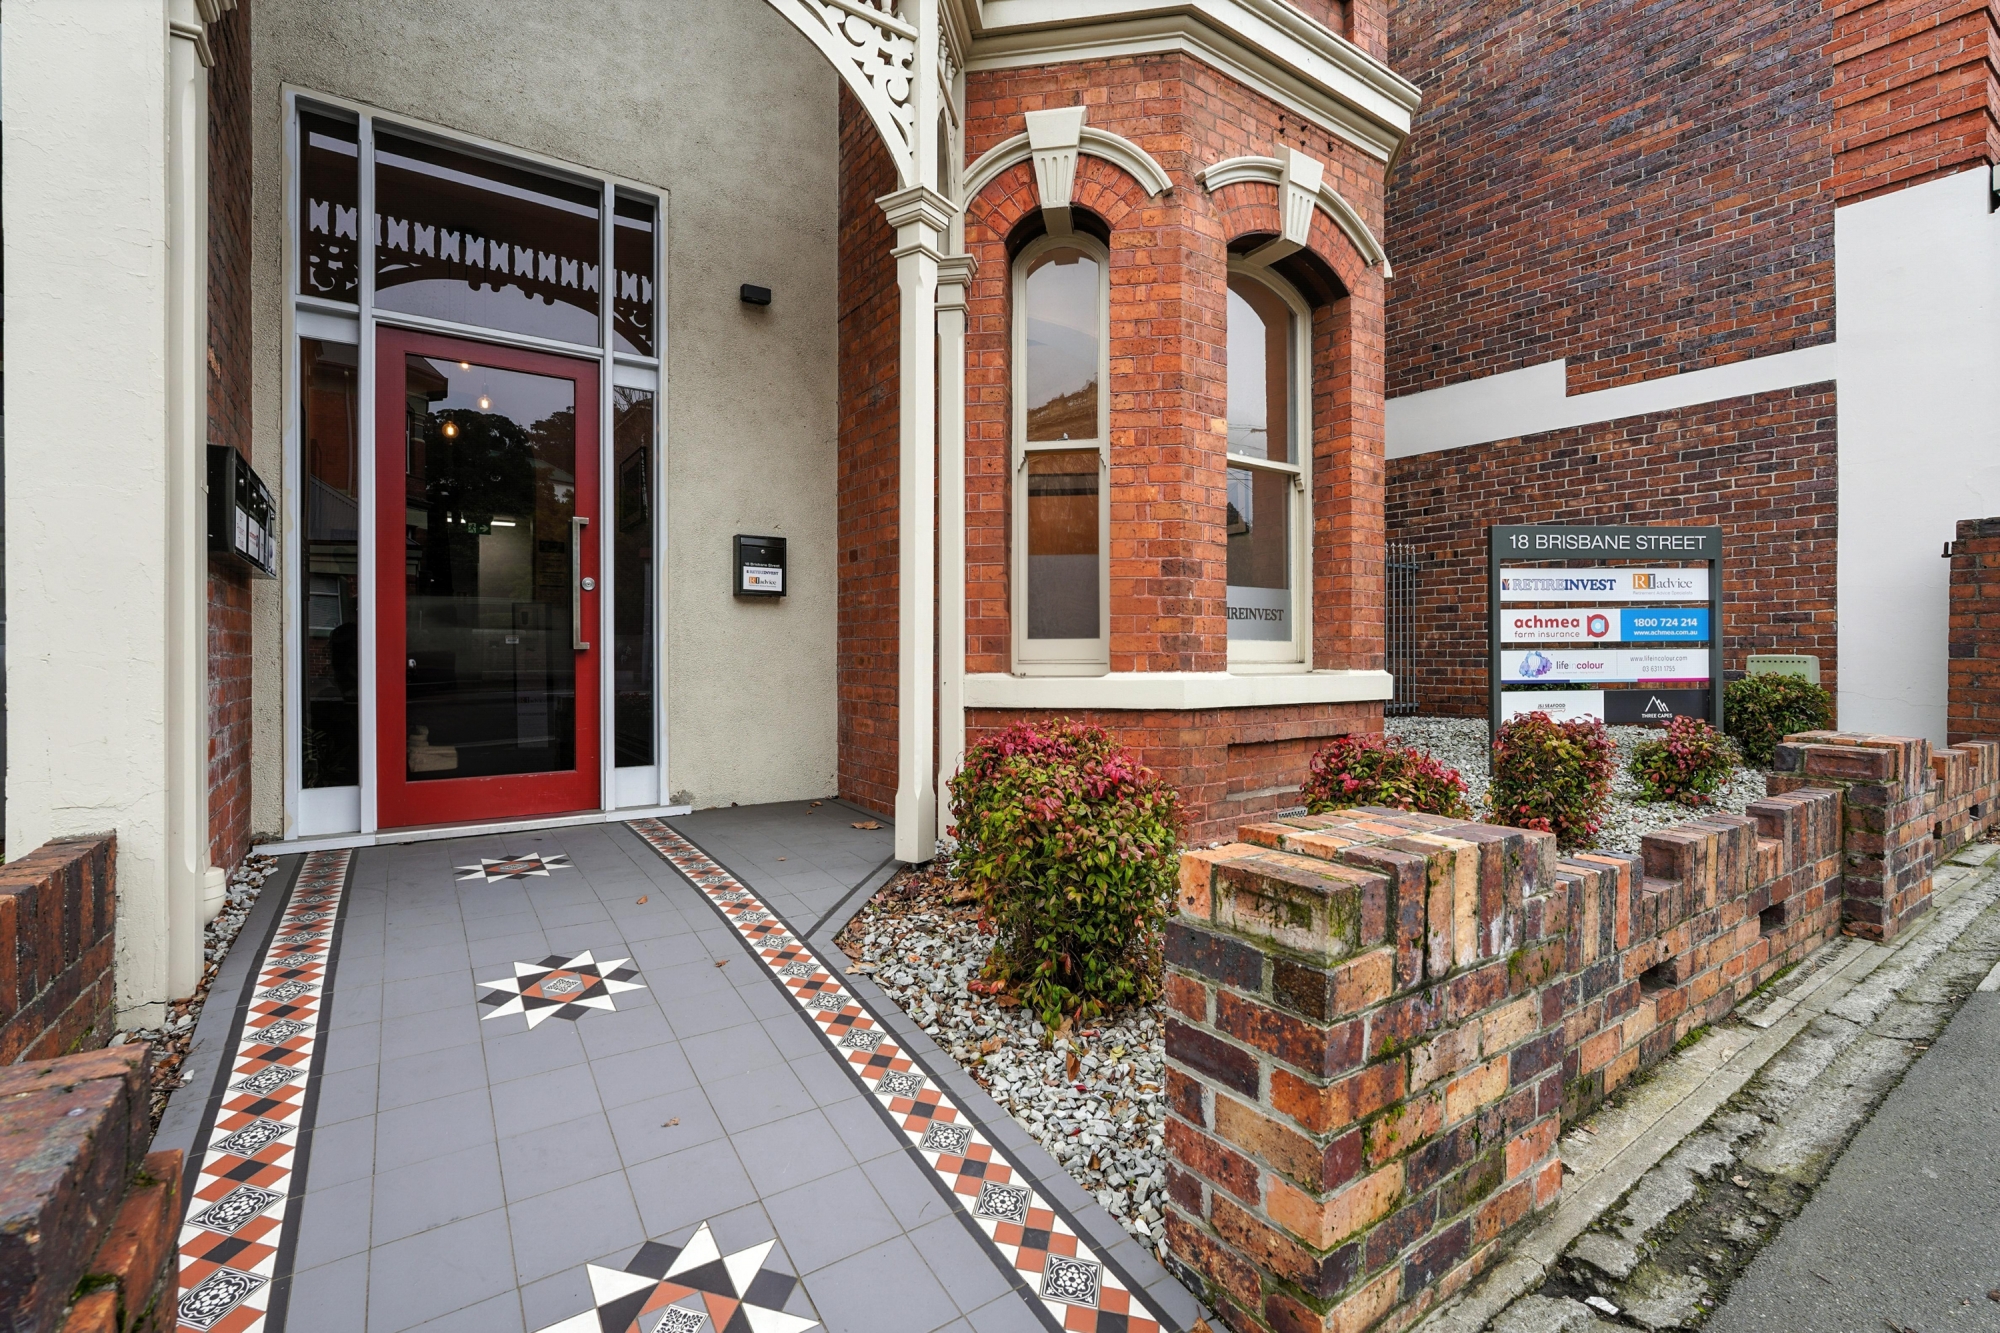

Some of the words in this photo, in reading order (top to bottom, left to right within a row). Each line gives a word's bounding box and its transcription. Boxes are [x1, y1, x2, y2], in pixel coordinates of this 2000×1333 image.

[1509, 534, 1529, 549] 18
[1535, 534, 1631, 550] BRISBANE
[1635, 535, 1707, 550] STREET
[1512, 578, 1617, 591] RETIREINVEST
[1514, 615, 1580, 628] achmea
[1633, 618, 1658, 627] 1800
[1659, 618, 1679, 627] 724
[1680, 618, 1698, 627] 214
[1514, 630, 1535, 638] farm
[1537, 630, 1580, 638] insurance
